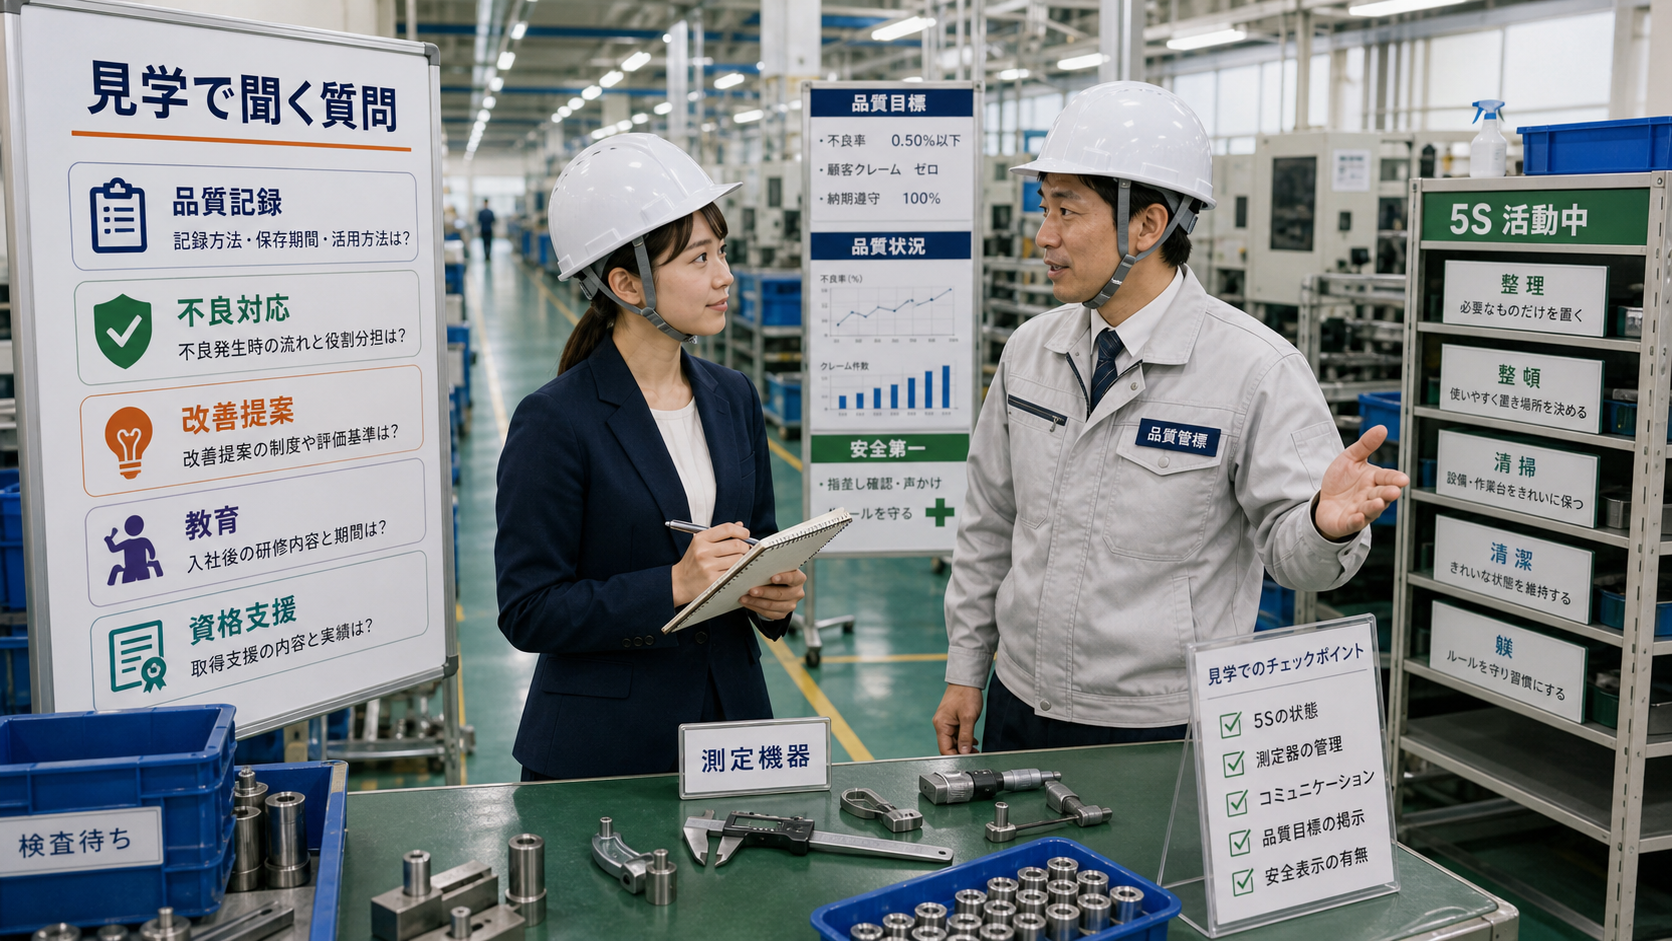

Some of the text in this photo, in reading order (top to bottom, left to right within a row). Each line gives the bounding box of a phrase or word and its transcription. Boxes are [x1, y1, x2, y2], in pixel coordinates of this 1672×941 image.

[87, 59, 398, 133] 見学で聞く質問
[851, 94, 926, 112] 品質目標
[892, 134, 960, 146] 0.50%以下
[915, 163, 938, 175] ゼロ
[173, 187, 282, 216] 品質記録
[904, 192, 940, 204] 100%
[1450, 203, 1587, 236] 5S 活動中
[174, 230, 409, 250] 記録方法・保存期間・活用方法は?
[851, 237, 926, 255] 品質状況
[1501, 274, 1544, 295] 整理
[178, 293, 290, 327] 不良対応
[1460, 301, 1583, 322] 必要なものだけを置く
[178, 328, 406, 361] 不良発生時の流れと役割分担は?
[820, 361, 869, 371] クレーム件数
[1498, 364, 1540, 388] 整頓
[182, 396, 294, 435] 改善提案
[1450, 387, 1587, 419] 使いやすく置き場所を決める
[183, 424, 399, 468] 改善提案の制度や評価基準は?
[851, 439, 925, 458] 安全第一
[1494, 452, 1535, 478] 清掃
[185, 505, 239, 541] 教育
[829, 506, 912, 521] ールを守る
[187, 520, 387, 573] 入社後の研修内容と期間は?
[1491, 542, 1532, 571] 清潔
[1450, 561, 1571, 605] きれいな状態を維持する
[189, 595, 297, 646] 資格支援
[190, 618, 373, 677] 取得支援の内容と実績は?
[1208, 643, 1364, 686] 見学でのチェックポイント
[1447, 650, 1566, 701] ルールを守り習慣にする
[1255, 702, 1318, 728] 5Sの状態
[702, 744, 809, 772] 測定機器
[1257, 736, 1343, 768] 測定器の管理
[1260, 770, 1375, 806] コミュニケーション
[19, 828, 130, 858] 検査待ち
[1262, 809, 1365, 848] 品質目標の掲示
[1265, 847, 1369, 886] 安全表示の有無
